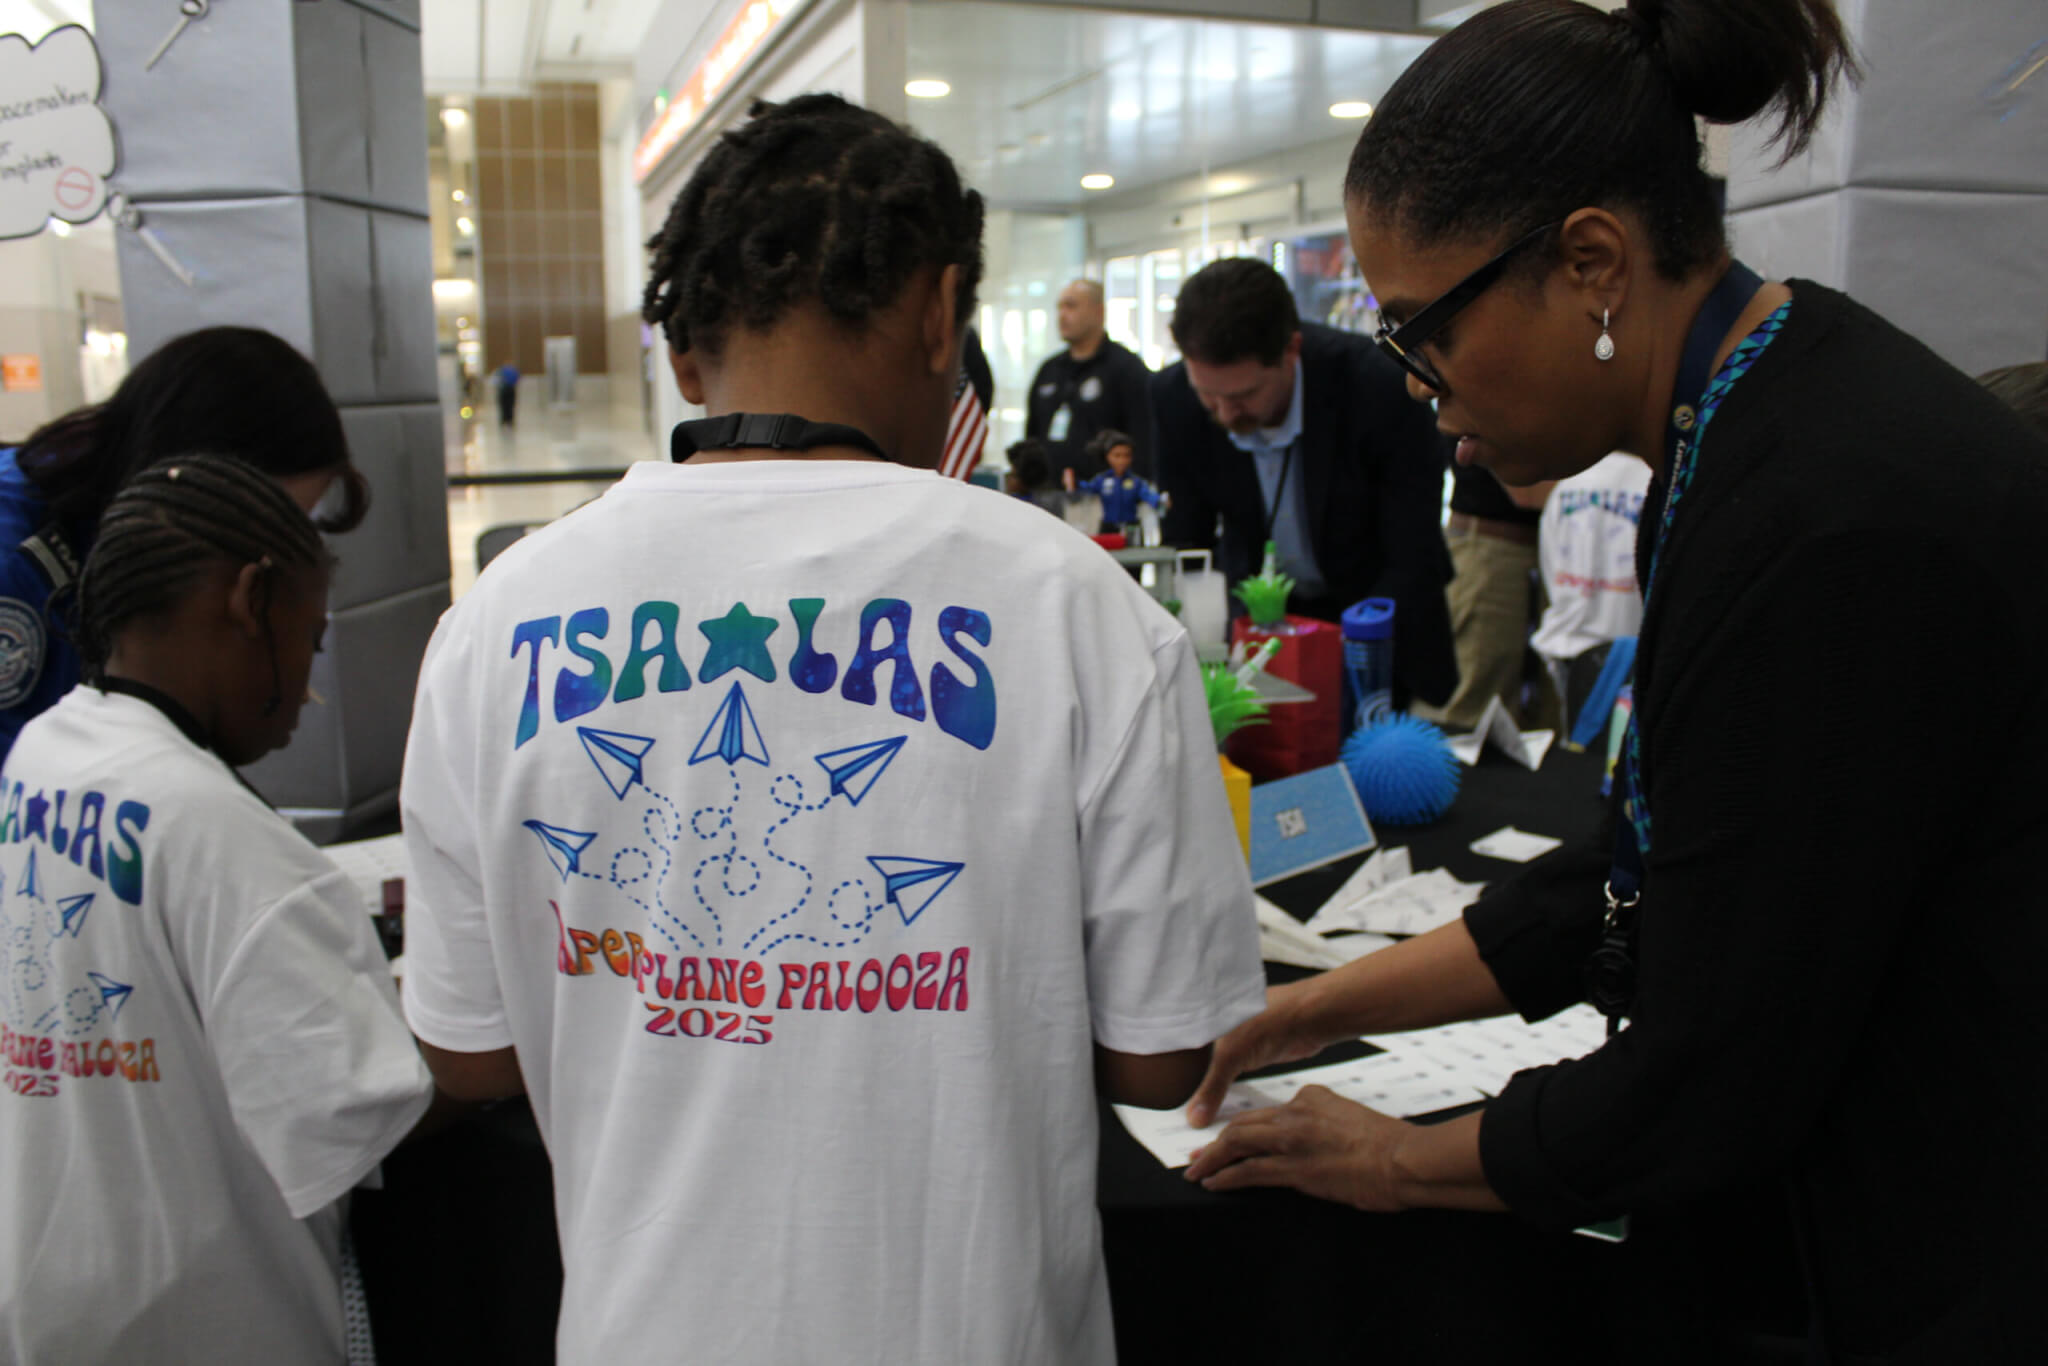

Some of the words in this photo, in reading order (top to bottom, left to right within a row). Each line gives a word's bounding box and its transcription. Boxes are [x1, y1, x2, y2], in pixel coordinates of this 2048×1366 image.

[510, 601, 692, 751] TSA
[789, 598, 997, 751] LAS
[51, 789, 151, 907] LAS
[644, 1001, 774, 1045] 2025
[777, 947, 970, 1013] PALOOZA
